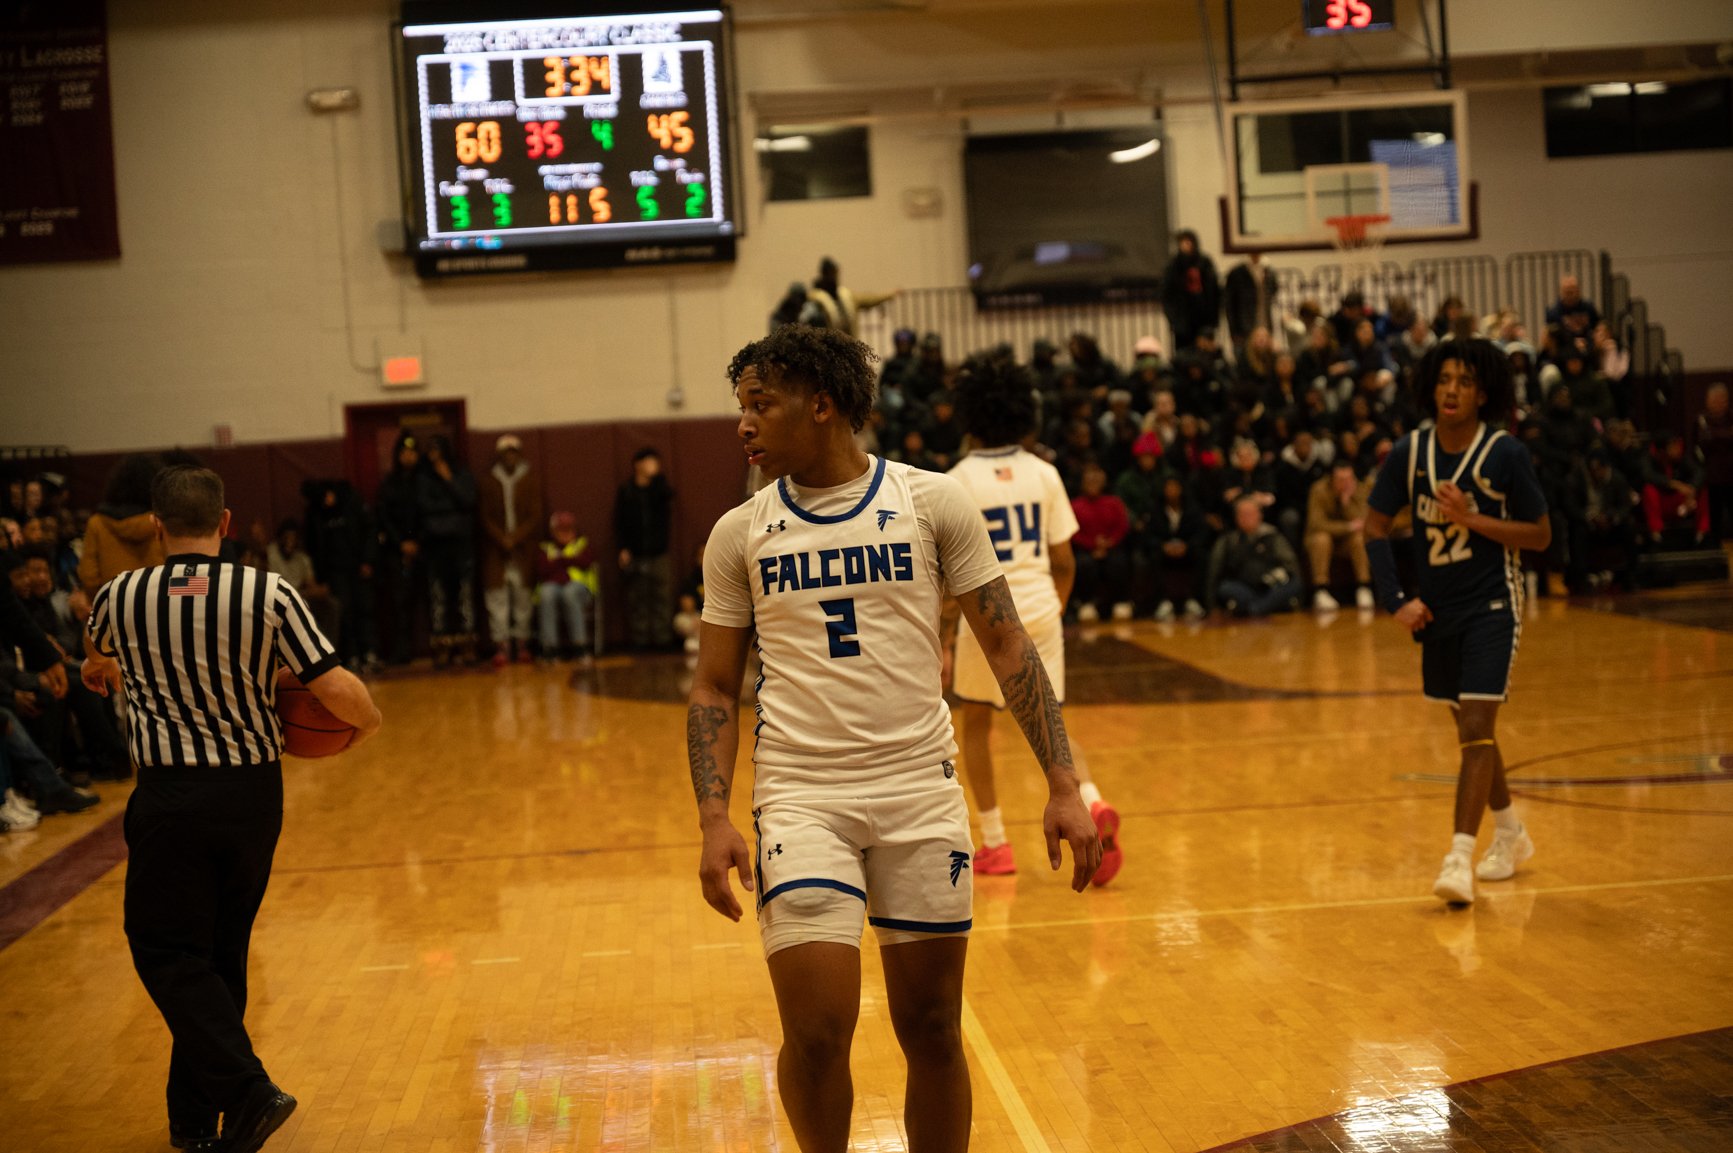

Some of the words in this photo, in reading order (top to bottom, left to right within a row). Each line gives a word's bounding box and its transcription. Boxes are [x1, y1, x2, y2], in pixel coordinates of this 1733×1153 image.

[1326, 0, 1372, 30] 35
[455, 121, 502, 164] 60
[524, 120, 564, 159] 35
[591, 119, 615, 151] 4
[647, 111, 695, 153] 45
[450, 194, 472, 230] 3
[492, 193, 513, 227] 3
[636, 185, 660, 220] 5
[685, 182, 708, 219] 2
[981, 502, 1042, 562] 24
[1425, 523, 1473, 566] 22
[758, 542, 914, 595] FALCONS
[818, 598, 861, 659] 2
